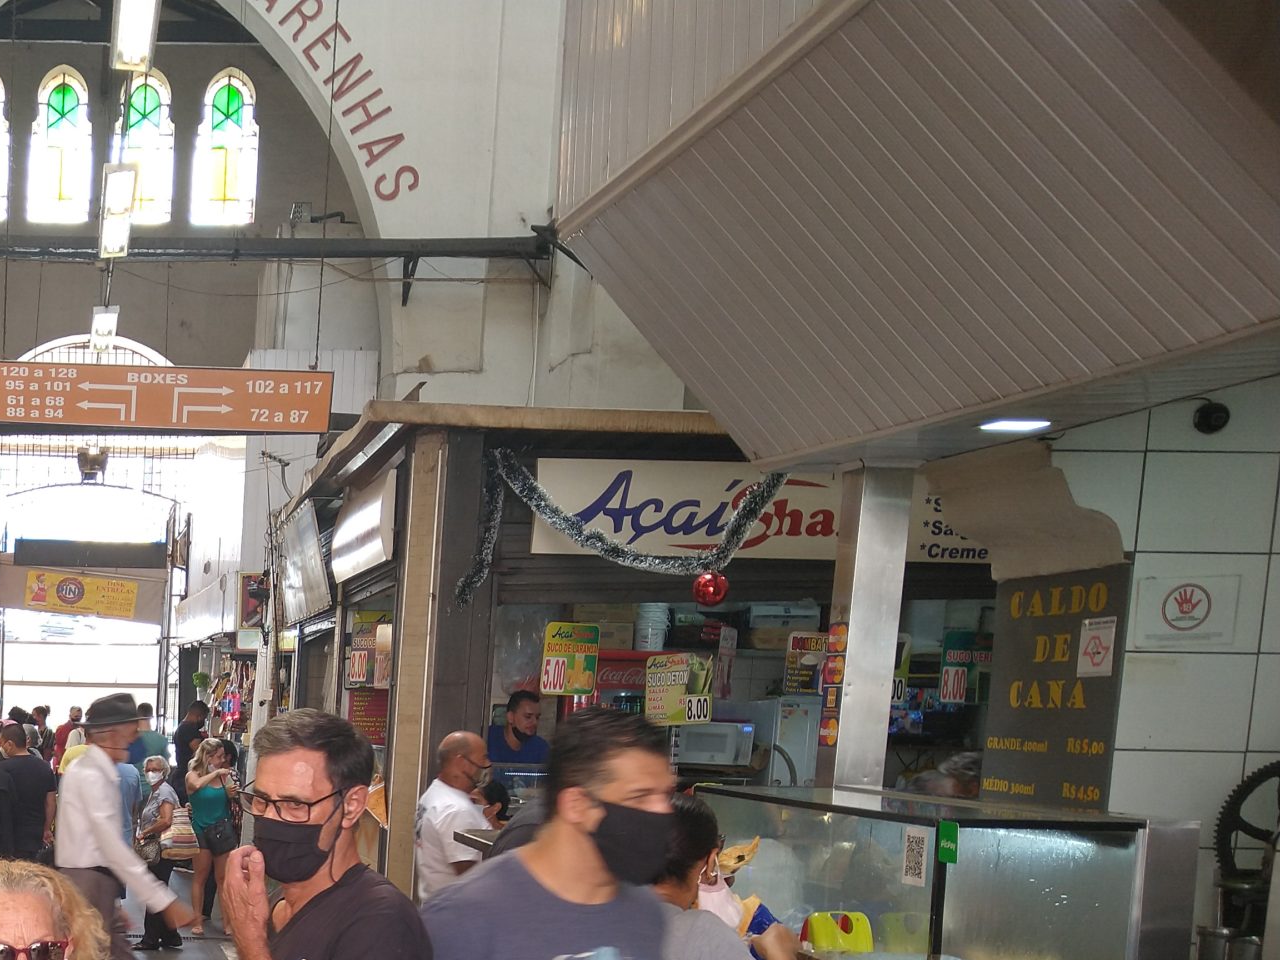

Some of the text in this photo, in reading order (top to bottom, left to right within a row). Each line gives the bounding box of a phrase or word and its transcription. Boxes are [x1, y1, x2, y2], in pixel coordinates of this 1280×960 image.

[0, 366, 78, 378] 120 a 128
[127, 372, 188, 385] BOXES
[5, 380, 71, 391] 95 a 101
[246, 380, 323, 395] 102 a 117
[7, 395, 65, 407] 61 a 68
[6, 407, 64, 418] 88 a 94
[250, 408, 309, 424] 72 a 87
[1010, 582, 1108, 620] CALDO
[352, 638, 368, 648] SUCO
[547, 643, 598, 654] SUCO DE LARANJA
[1033, 634, 1071, 664] DE
[946, 650, 971, 662] SUCO
[350, 653, 366, 680] 8.00
[543, 659, 566, 690] 5.00
[647, 671, 689, 686] SUCO DETOX
[941, 668, 966, 701] 8.00
[1009, 680, 1087, 710] CANA
[686, 697, 708, 720] 8.00
[987, 737, 1022, 751] GRANDE
[1067, 738, 1080, 753] R$
[982, 777, 1076, 799] MÉDIO 300ml R$
